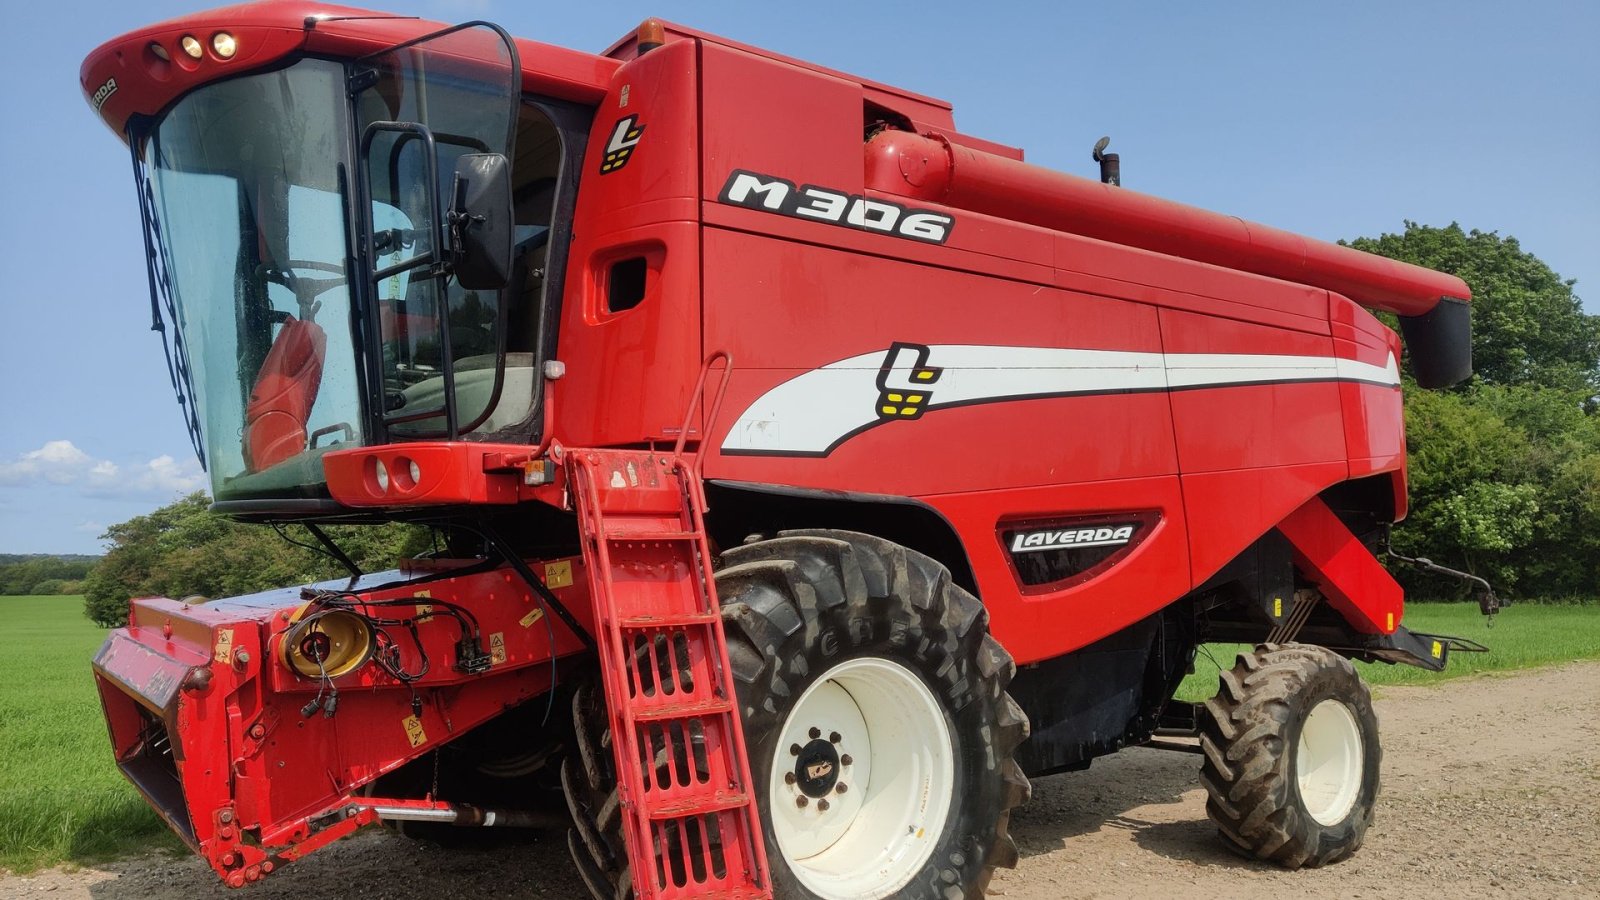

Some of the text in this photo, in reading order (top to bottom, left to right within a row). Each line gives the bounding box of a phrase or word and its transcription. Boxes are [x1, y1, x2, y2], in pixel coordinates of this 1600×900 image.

[91, 77, 118, 109] ERDA
[728, 173, 951, 241] M 306
[1012, 526, 1133, 552] LAVERDA
